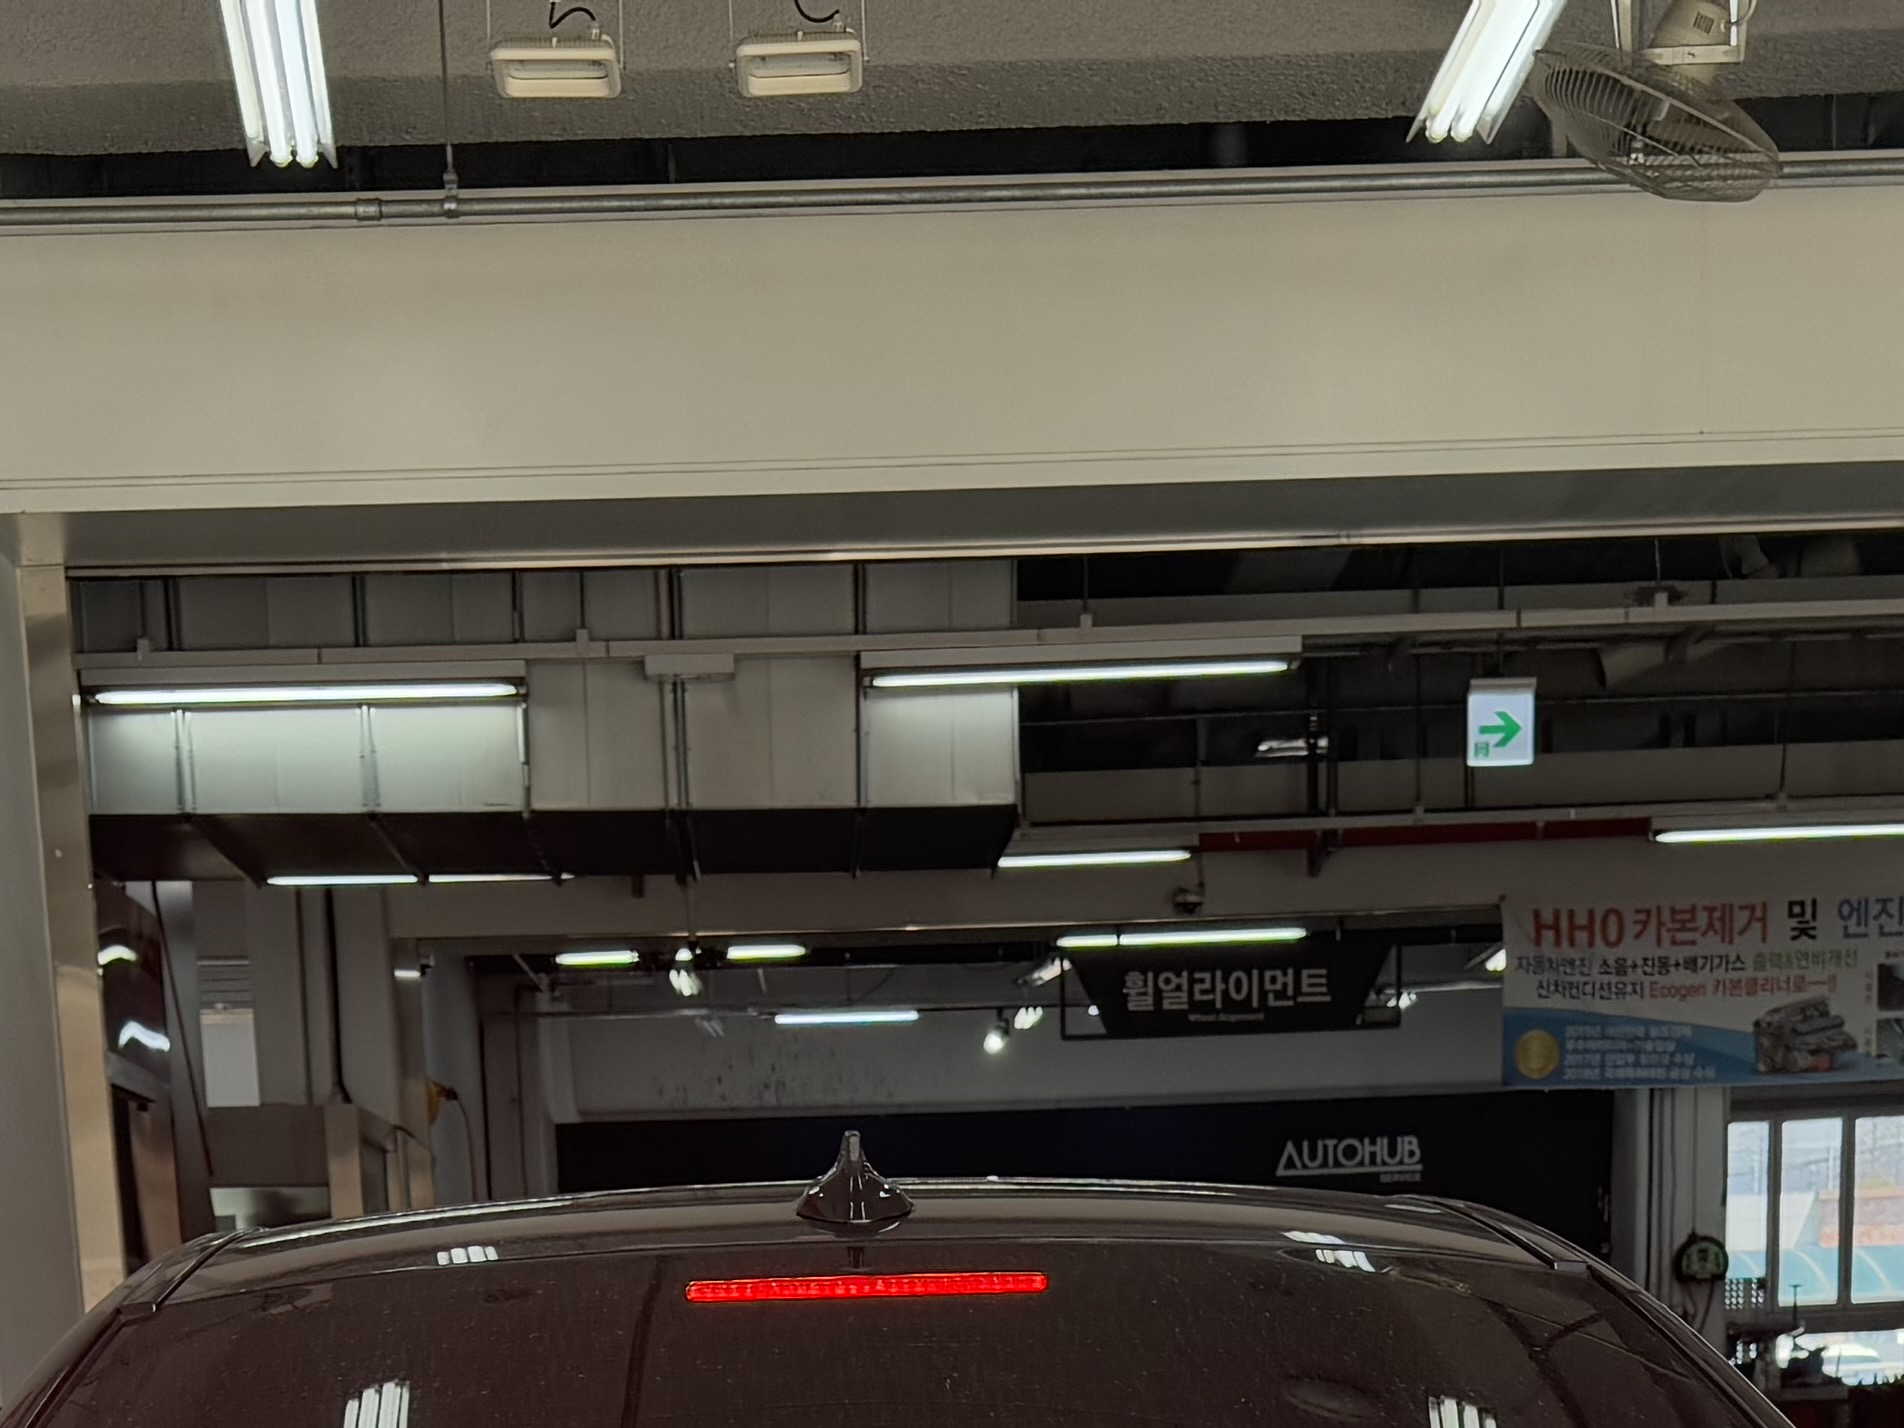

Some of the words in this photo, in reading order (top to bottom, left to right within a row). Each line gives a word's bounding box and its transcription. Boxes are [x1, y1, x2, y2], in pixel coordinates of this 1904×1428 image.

[1633, 900, 1770, 947] 카본제거
[1787, 897, 1818, 942] 및
[1122, 965, 1333, 1012] 휠얼라이먼트
[1275, 1133, 1424, 1177] AUTOHUB
